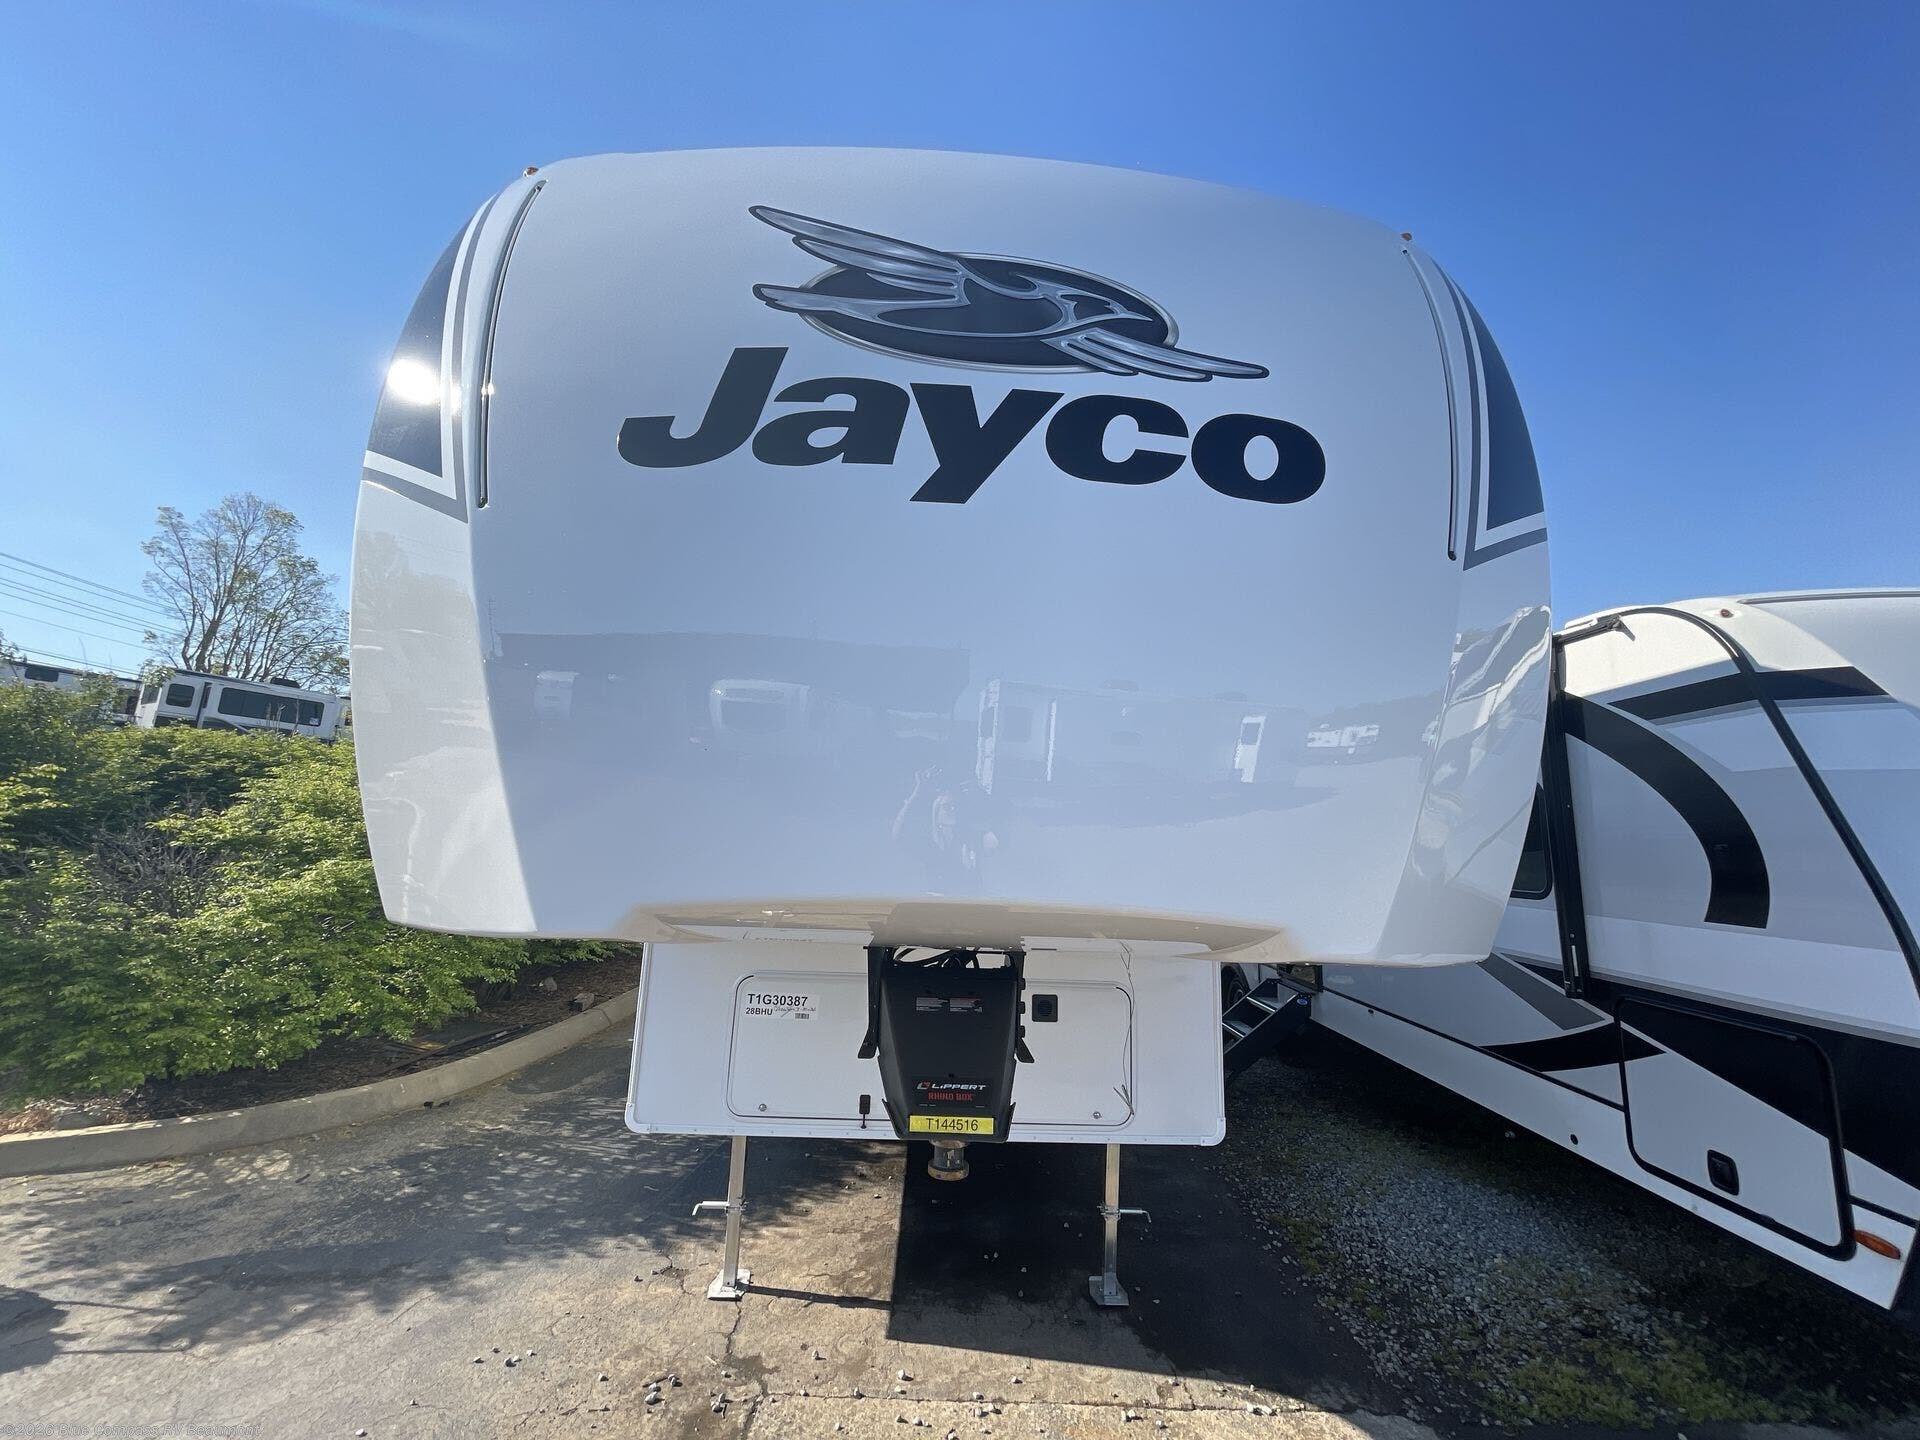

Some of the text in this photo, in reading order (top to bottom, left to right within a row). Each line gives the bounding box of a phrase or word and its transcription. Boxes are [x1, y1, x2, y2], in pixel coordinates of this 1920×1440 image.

[617, 347, 1326, 504] Jayco
[747, 993, 808, 1007] T1G30387
[745, 1007, 773, 1016] 28BHU
[931, 1083, 987, 1091] LIPPERT
[928, 1092, 954, 1101] RHINO
[925, 1117, 979, 1132] T144516
